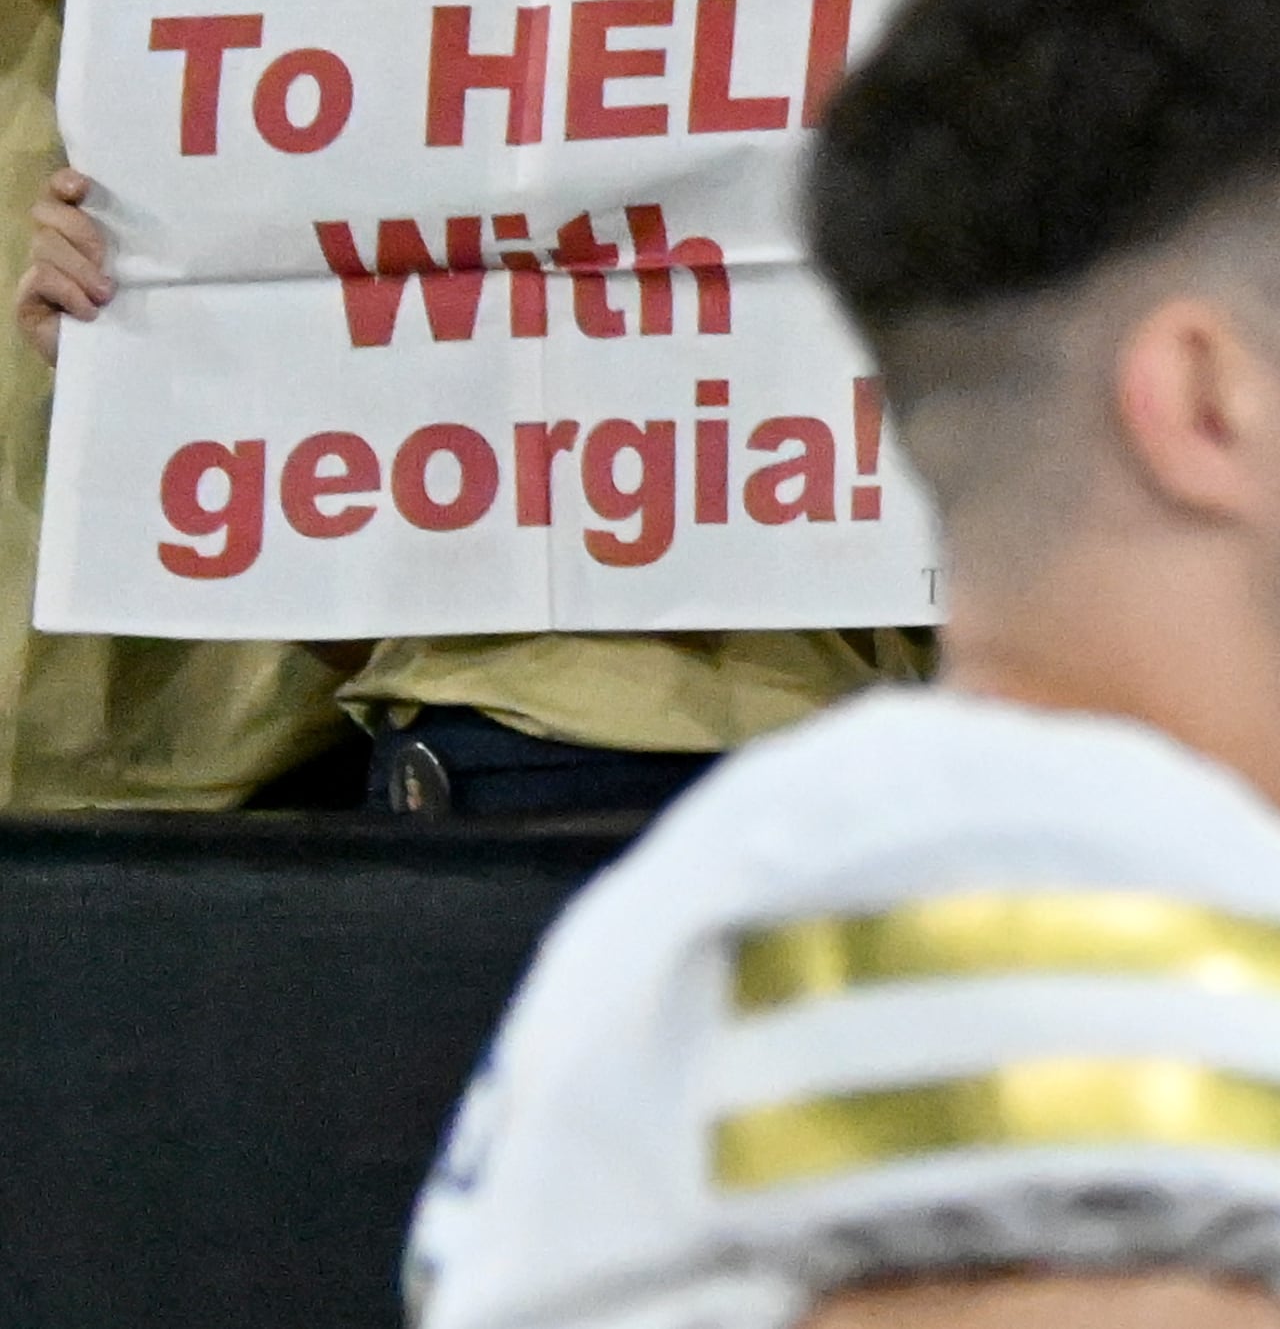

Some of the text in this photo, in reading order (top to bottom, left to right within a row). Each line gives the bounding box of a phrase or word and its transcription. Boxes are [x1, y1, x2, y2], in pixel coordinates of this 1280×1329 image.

[148, 13, 354, 157] To
[313, 203, 733, 349] With
[157, 376, 884, 581] georgia!
